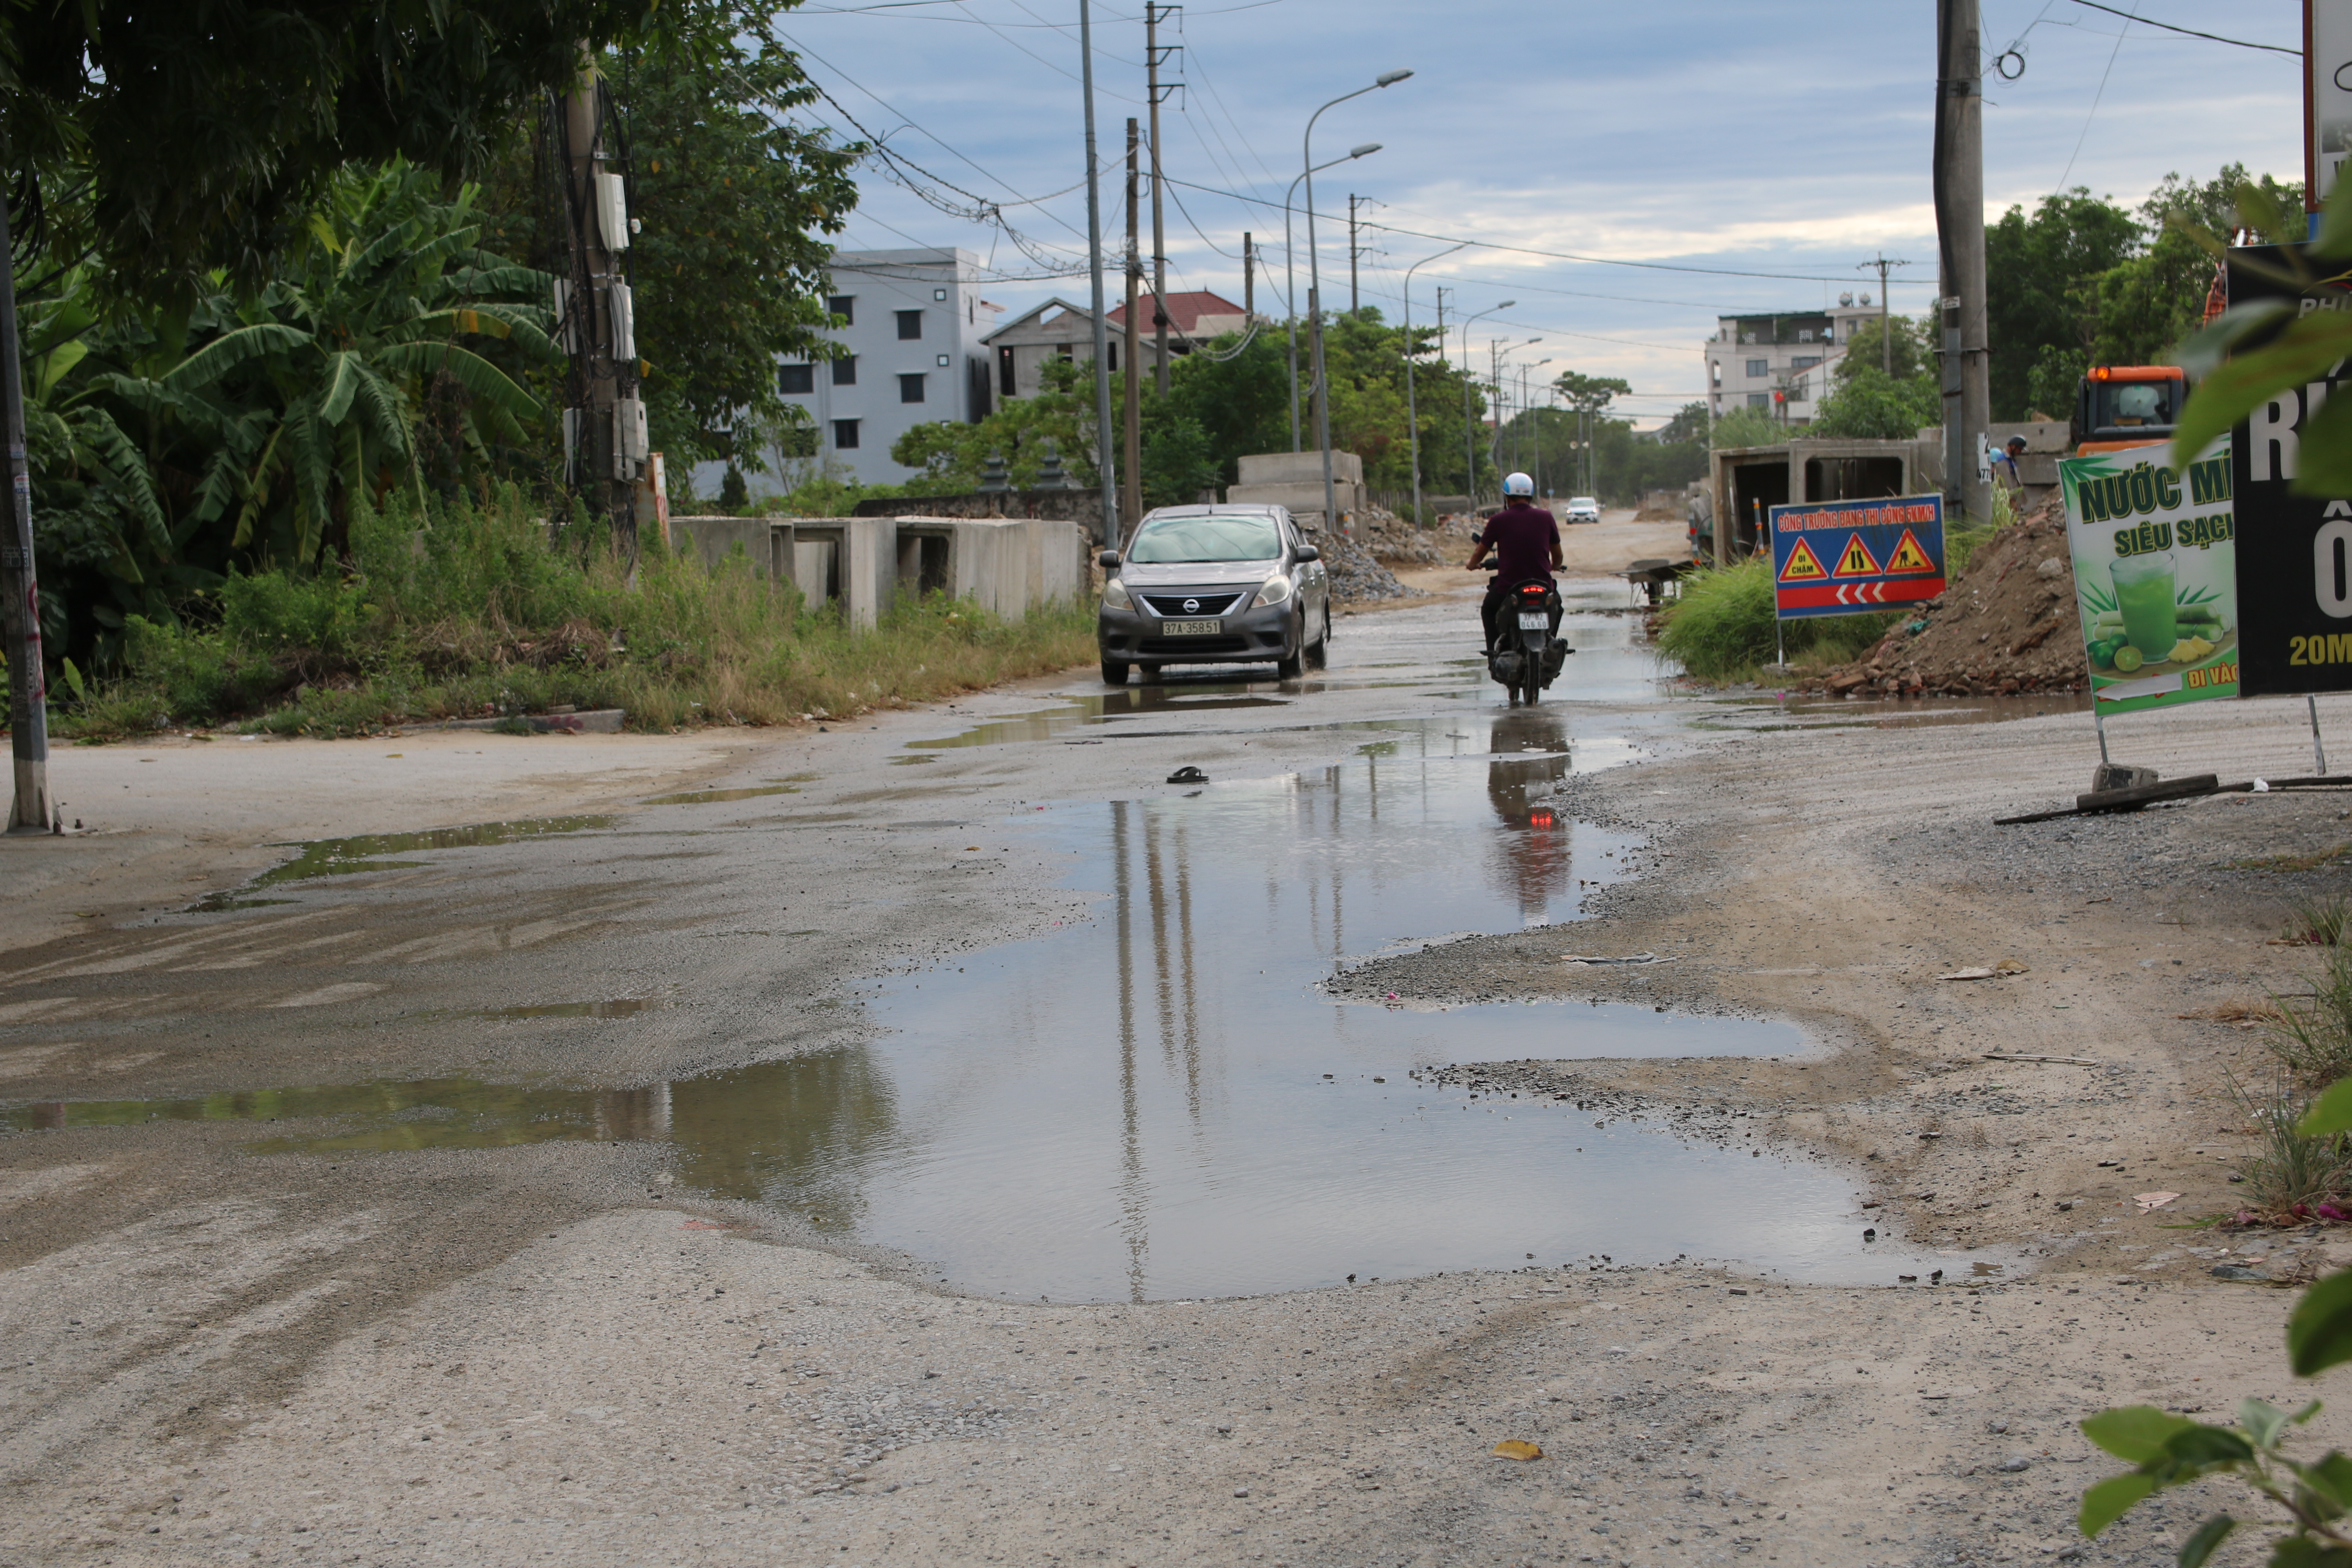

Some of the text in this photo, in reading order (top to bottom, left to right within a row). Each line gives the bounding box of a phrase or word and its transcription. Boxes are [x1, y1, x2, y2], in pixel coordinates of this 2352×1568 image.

[2078, 461, 2181, 524] NƯỚC
[1778, 512, 1802, 532] CÔNG
[1803, 508, 1838, 530] TRƯỜNG
[1839, 509, 1864, 528] ĐANG
[1864, 508, 1879, 526] THI
[1880, 503, 1905, 524] CÔNG
[2114, 521, 2172, 557] SIÊU
[2187, 669, 2207, 689] ĐI
